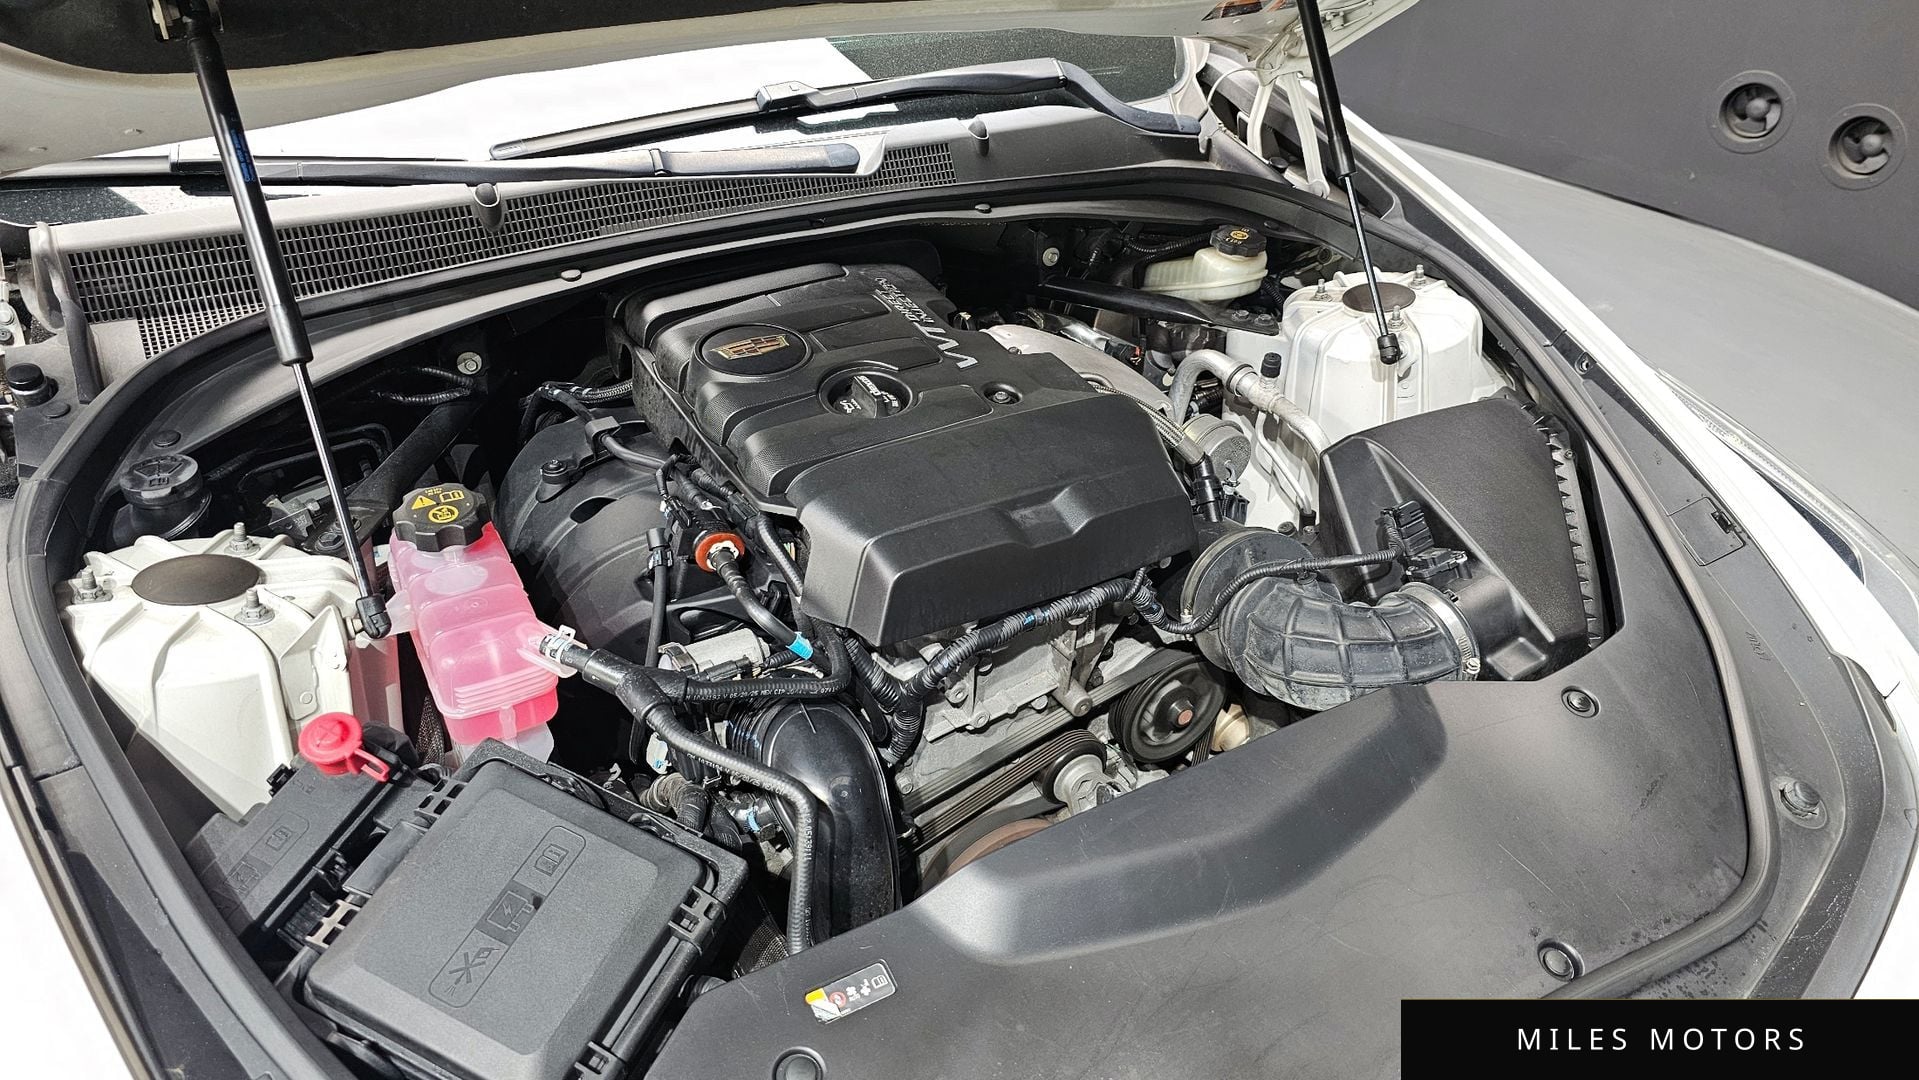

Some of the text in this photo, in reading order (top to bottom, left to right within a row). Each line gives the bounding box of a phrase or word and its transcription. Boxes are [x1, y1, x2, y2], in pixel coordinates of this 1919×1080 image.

[875, 277, 935, 324] INJECTION
[875, 288, 919, 323] DIRECT
[913, 322, 979, 369] VVT
